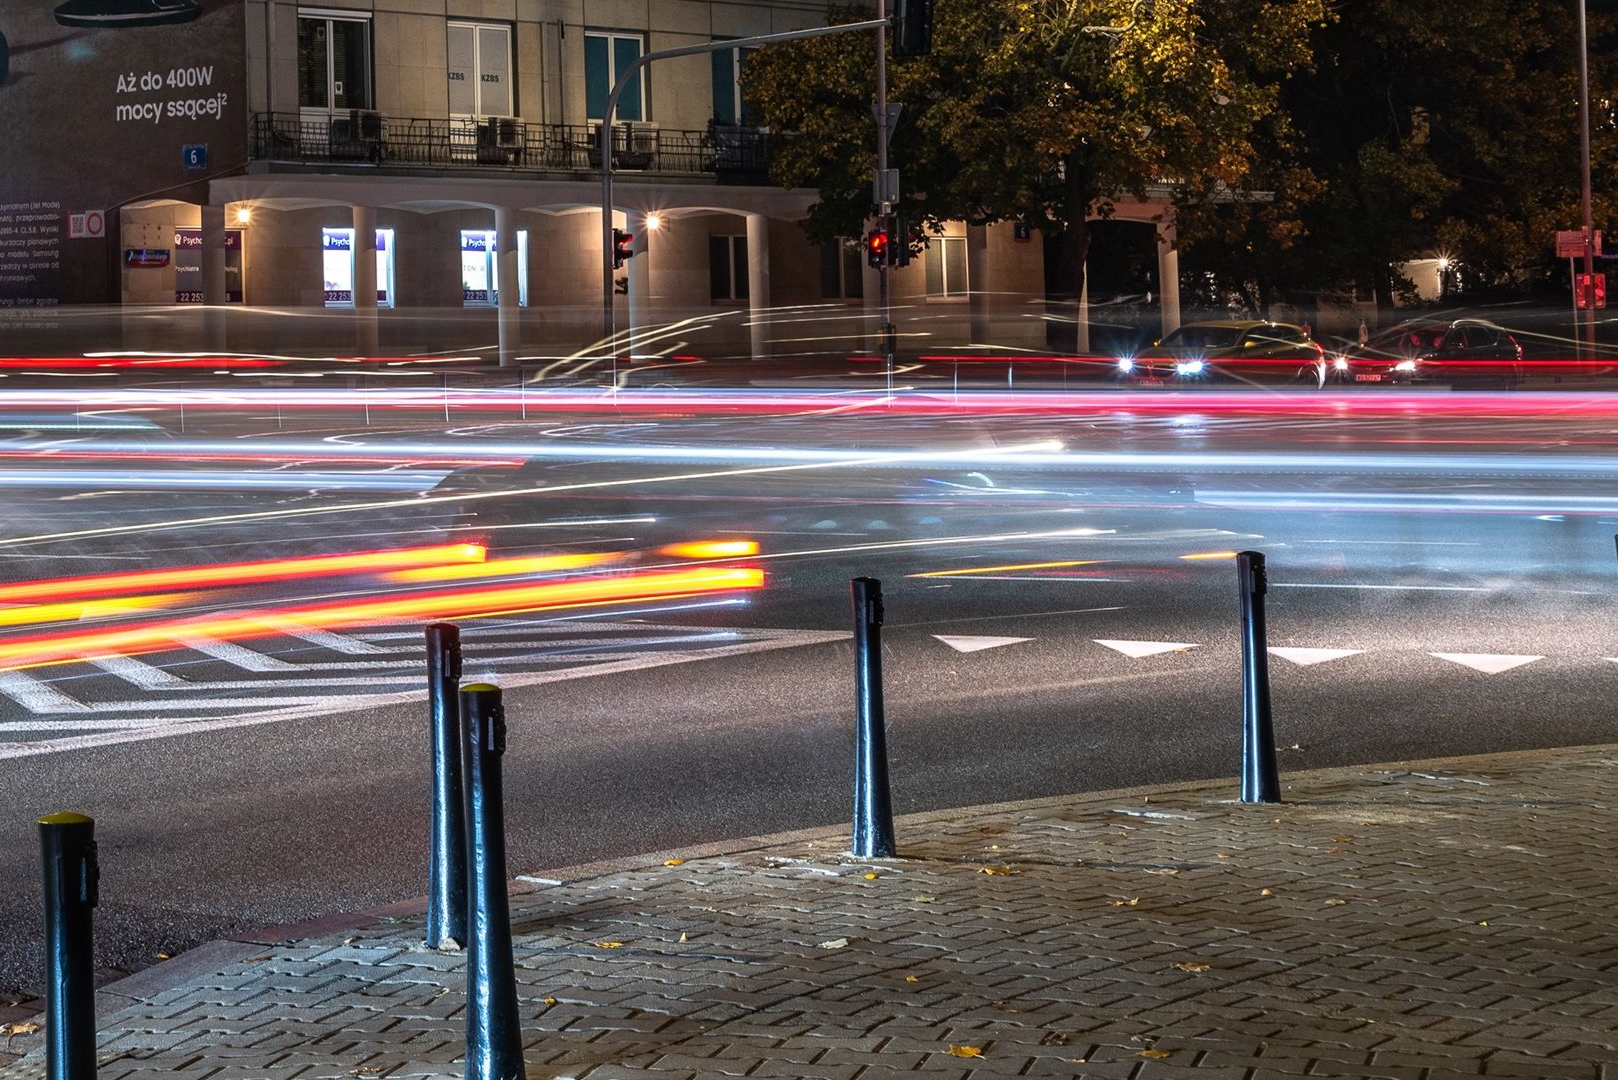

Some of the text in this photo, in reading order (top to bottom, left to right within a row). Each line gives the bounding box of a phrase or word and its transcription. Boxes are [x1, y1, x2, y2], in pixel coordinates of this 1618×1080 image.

[116, 66, 213, 93] Aż do 400W
[116, 102, 163, 124] mocy
[190, 150, 197, 164] 6
